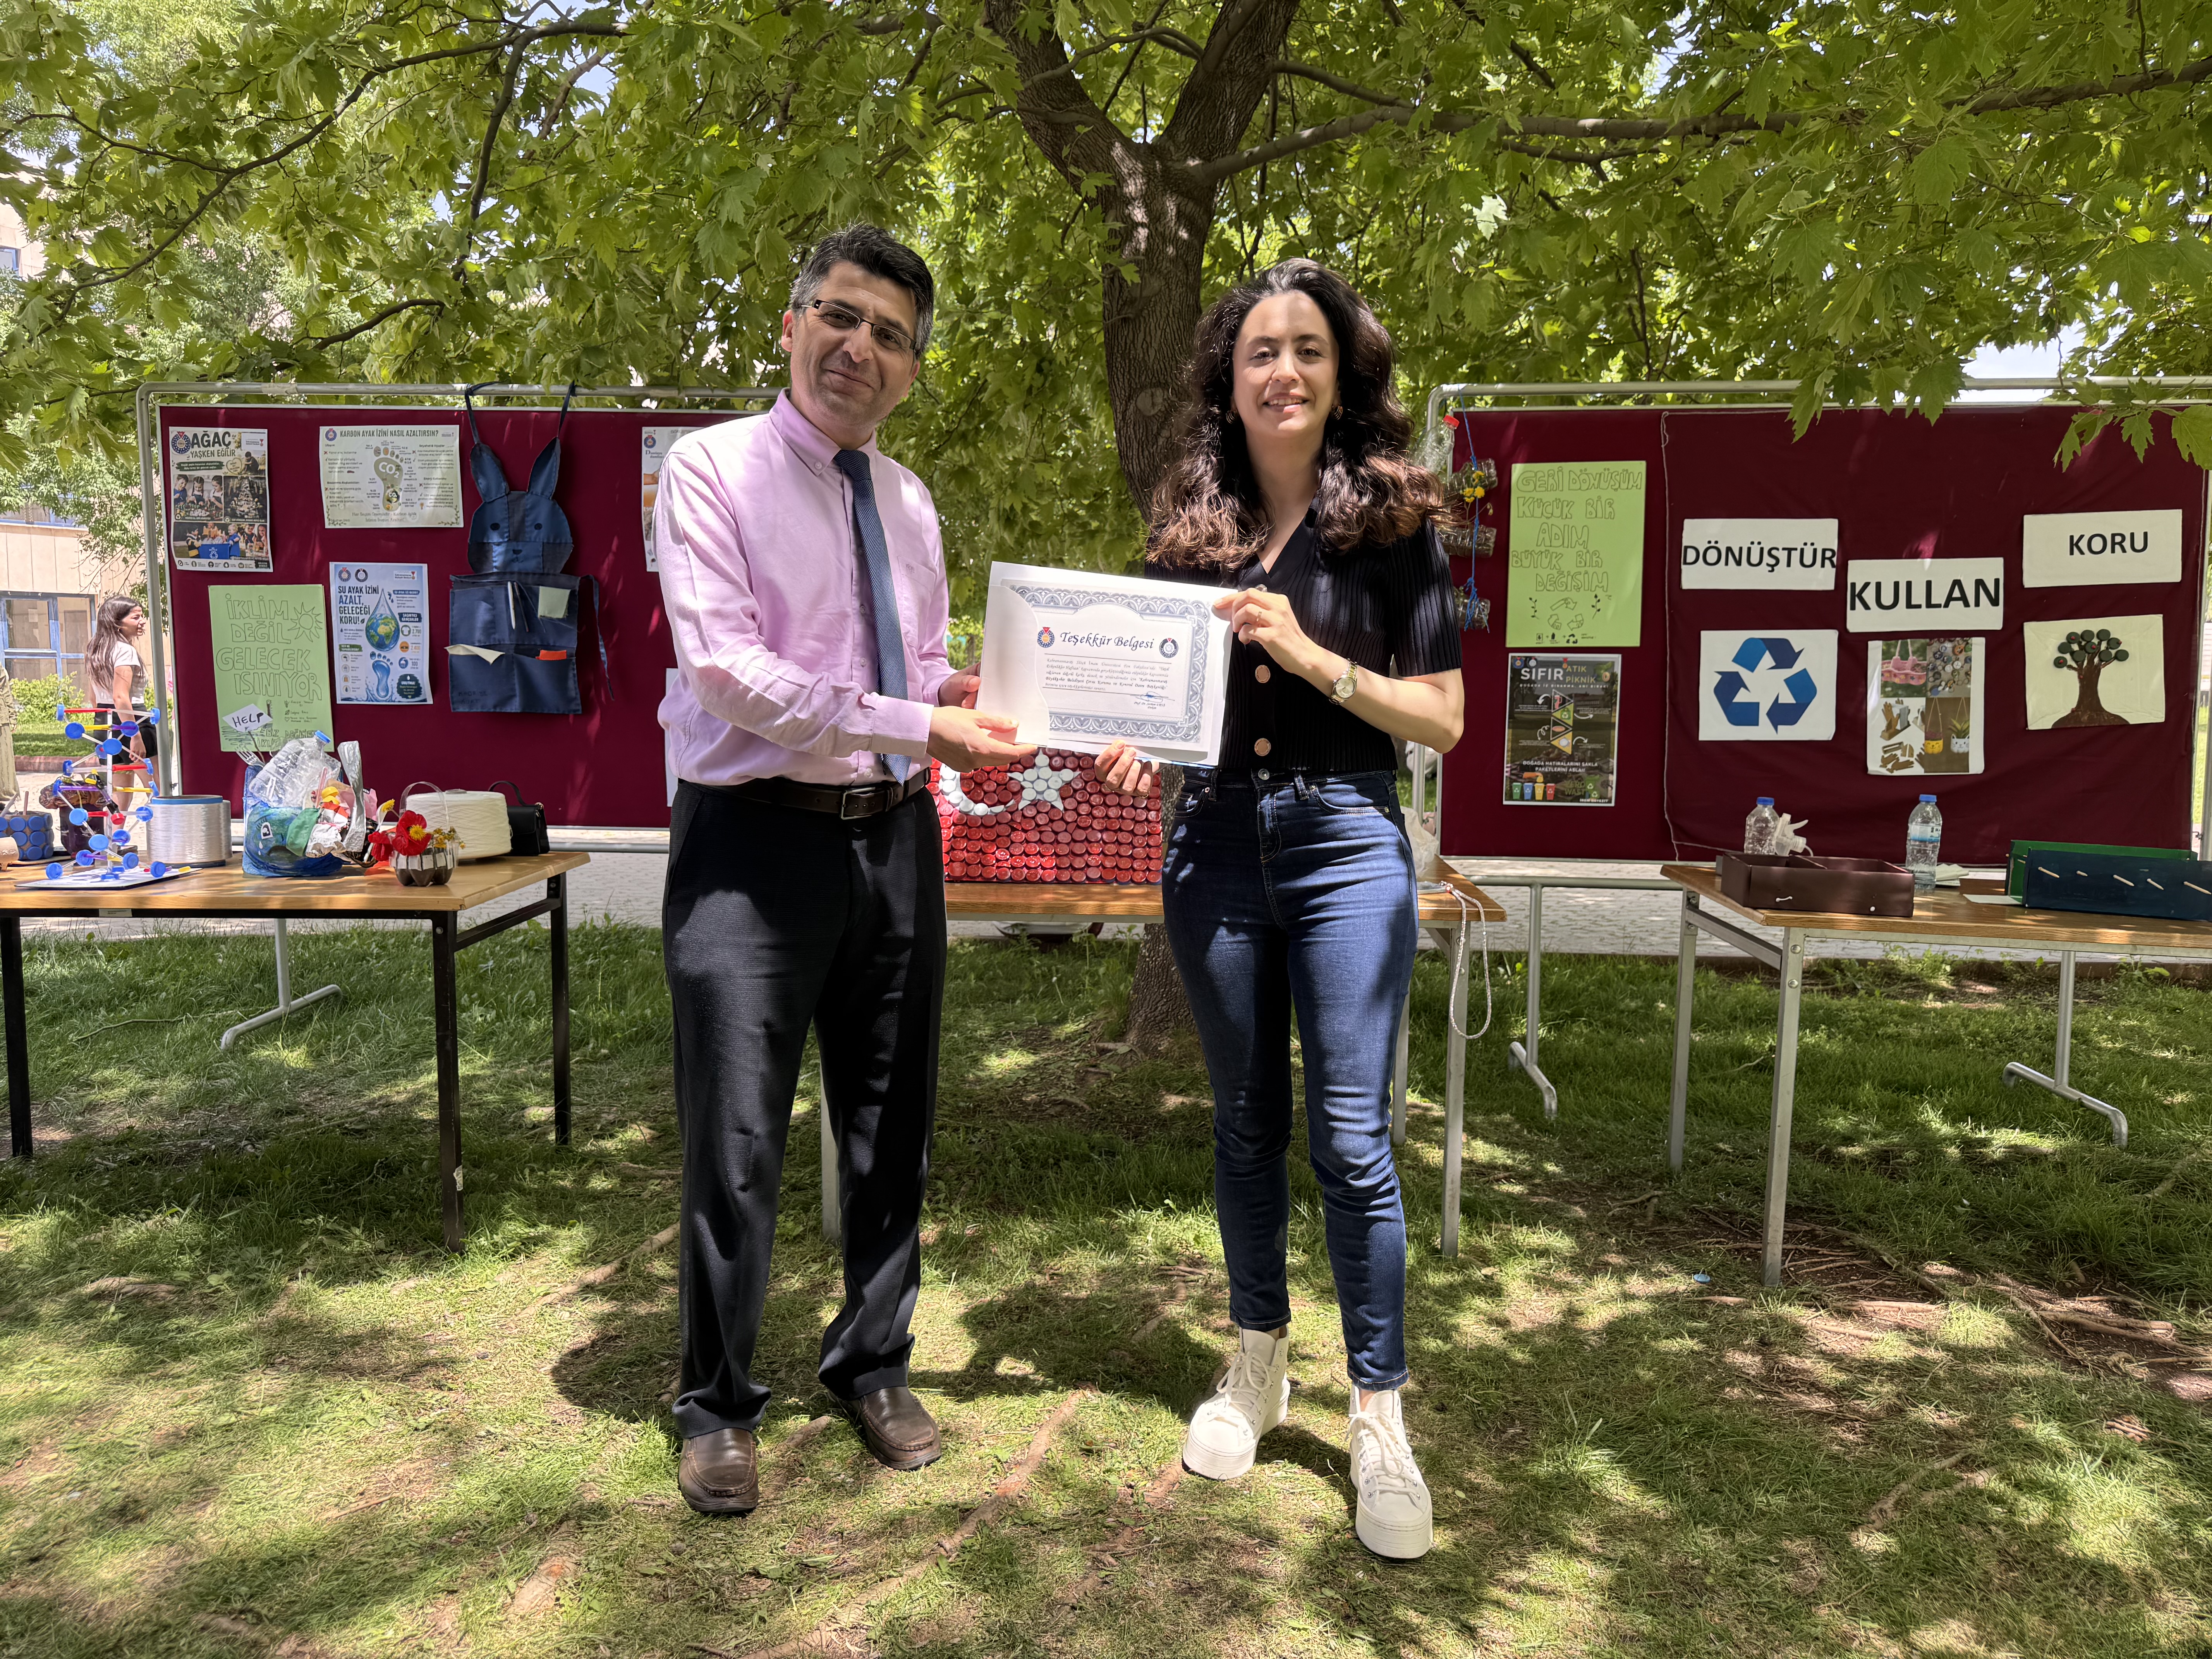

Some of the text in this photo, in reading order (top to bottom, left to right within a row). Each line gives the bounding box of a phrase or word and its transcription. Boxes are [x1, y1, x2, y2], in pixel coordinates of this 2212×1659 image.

[191, 430, 231, 449] AĞAÇ
[376, 429, 388, 437] İZİNİ
[191, 448, 235, 459] YAŞKEN EĞİLİR
[1516, 466, 1642, 492] GERİ DÖNÜŞÜM
[1517, 496, 1614, 520] KÜÇÜK BİR
[1536, 522, 1589, 549] ADIM
[2069, 531, 2148, 556] KORU
[1511, 550, 1603, 570] BÜYÜK BİR
[1682, 540, 1836, 572] DÖNÜŞTÜR
[348, 586, 363, 594] AYAK
[365, 585, 379, 594] İZİNİ
[1536, 570, 1608, 592] DEĞİŞİM
[339, 595, 364, 606] AZALT,
[1849, 578, 2000, 611] KULLAN
[225, 593, 289, 620] İKLİM
[339, 605, 370, 615] GELECEĞİ
[340, 616, 359, 624] KORU!
[231, 620, 291, 644] DEĞİL
[1060, 632, 1154, 651] Teşekkür Belgesi
[216, 647, 311, 672] GELECEK
[1520, 668, 1563, 680] SIFIR
[1566, 675, 1597, 684] PİKNİK
[234, 671, 322, 701] ISINIYOR
[232, 712, 264, 727] HELP
